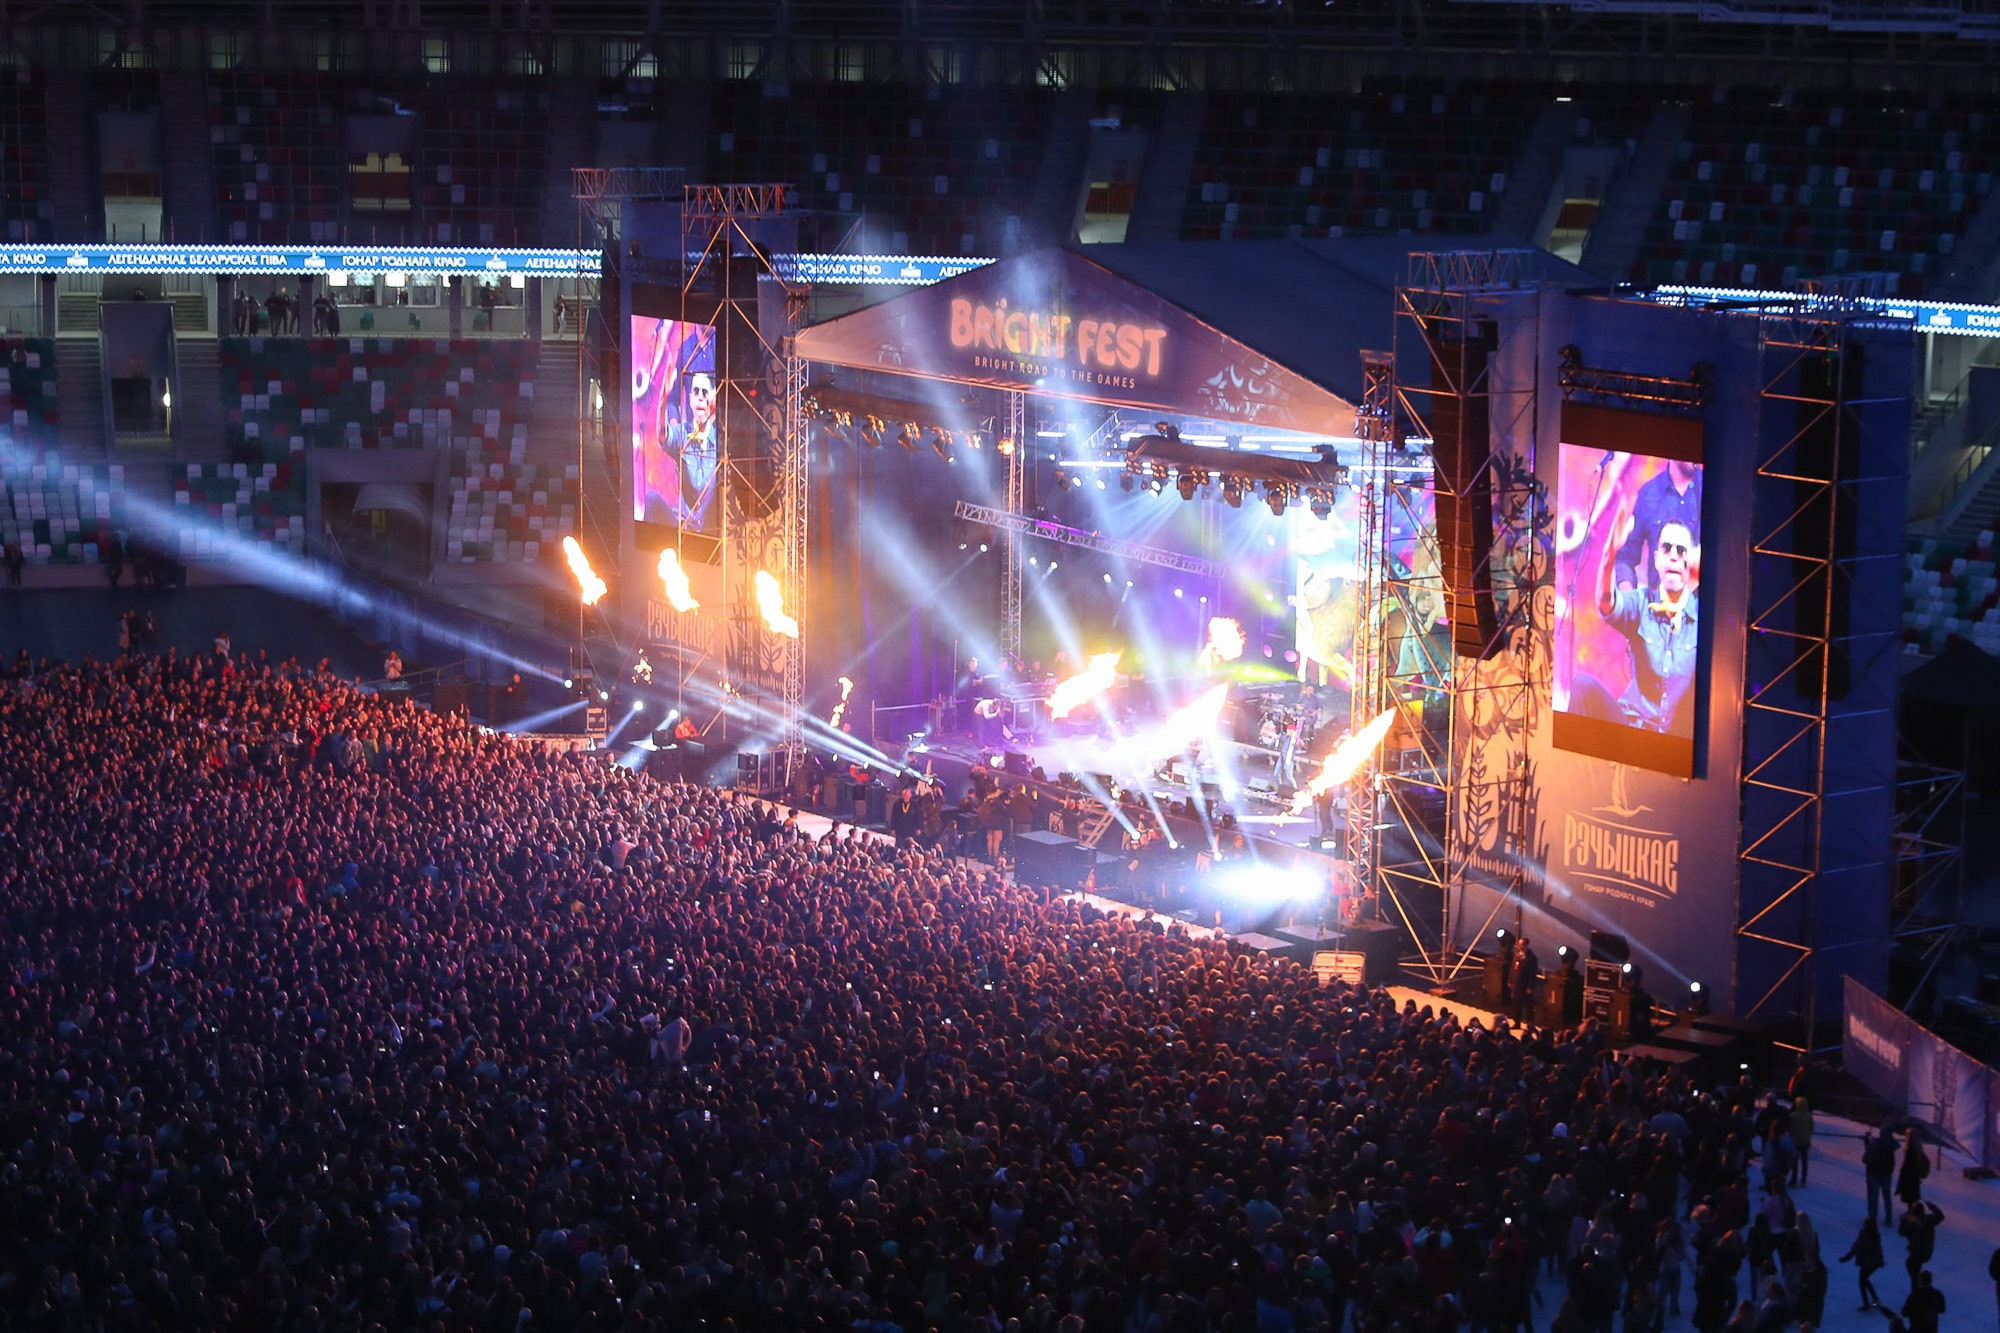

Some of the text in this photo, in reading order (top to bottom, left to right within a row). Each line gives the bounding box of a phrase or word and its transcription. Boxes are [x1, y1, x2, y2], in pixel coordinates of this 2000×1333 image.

[13, 254, 46, 265] КРАЮ
[107, 253, 186, 265] ЛЕГЕНДАРНАЕ
[189, 254, 258, 265] БЕЛАРУСКАЕ
[342, 255, 466, 268] ГОНАР РОДНАГА КРАЮ
[849, 264, 882, 276] КРАЮ
[1078, 320, 1168, 377] FEST
[974, 356, 1136, 389] BRIGHT ROAD TO THE GAMES
[1563, 813, 1680, 895] РЭЧЫЦКАЕ
